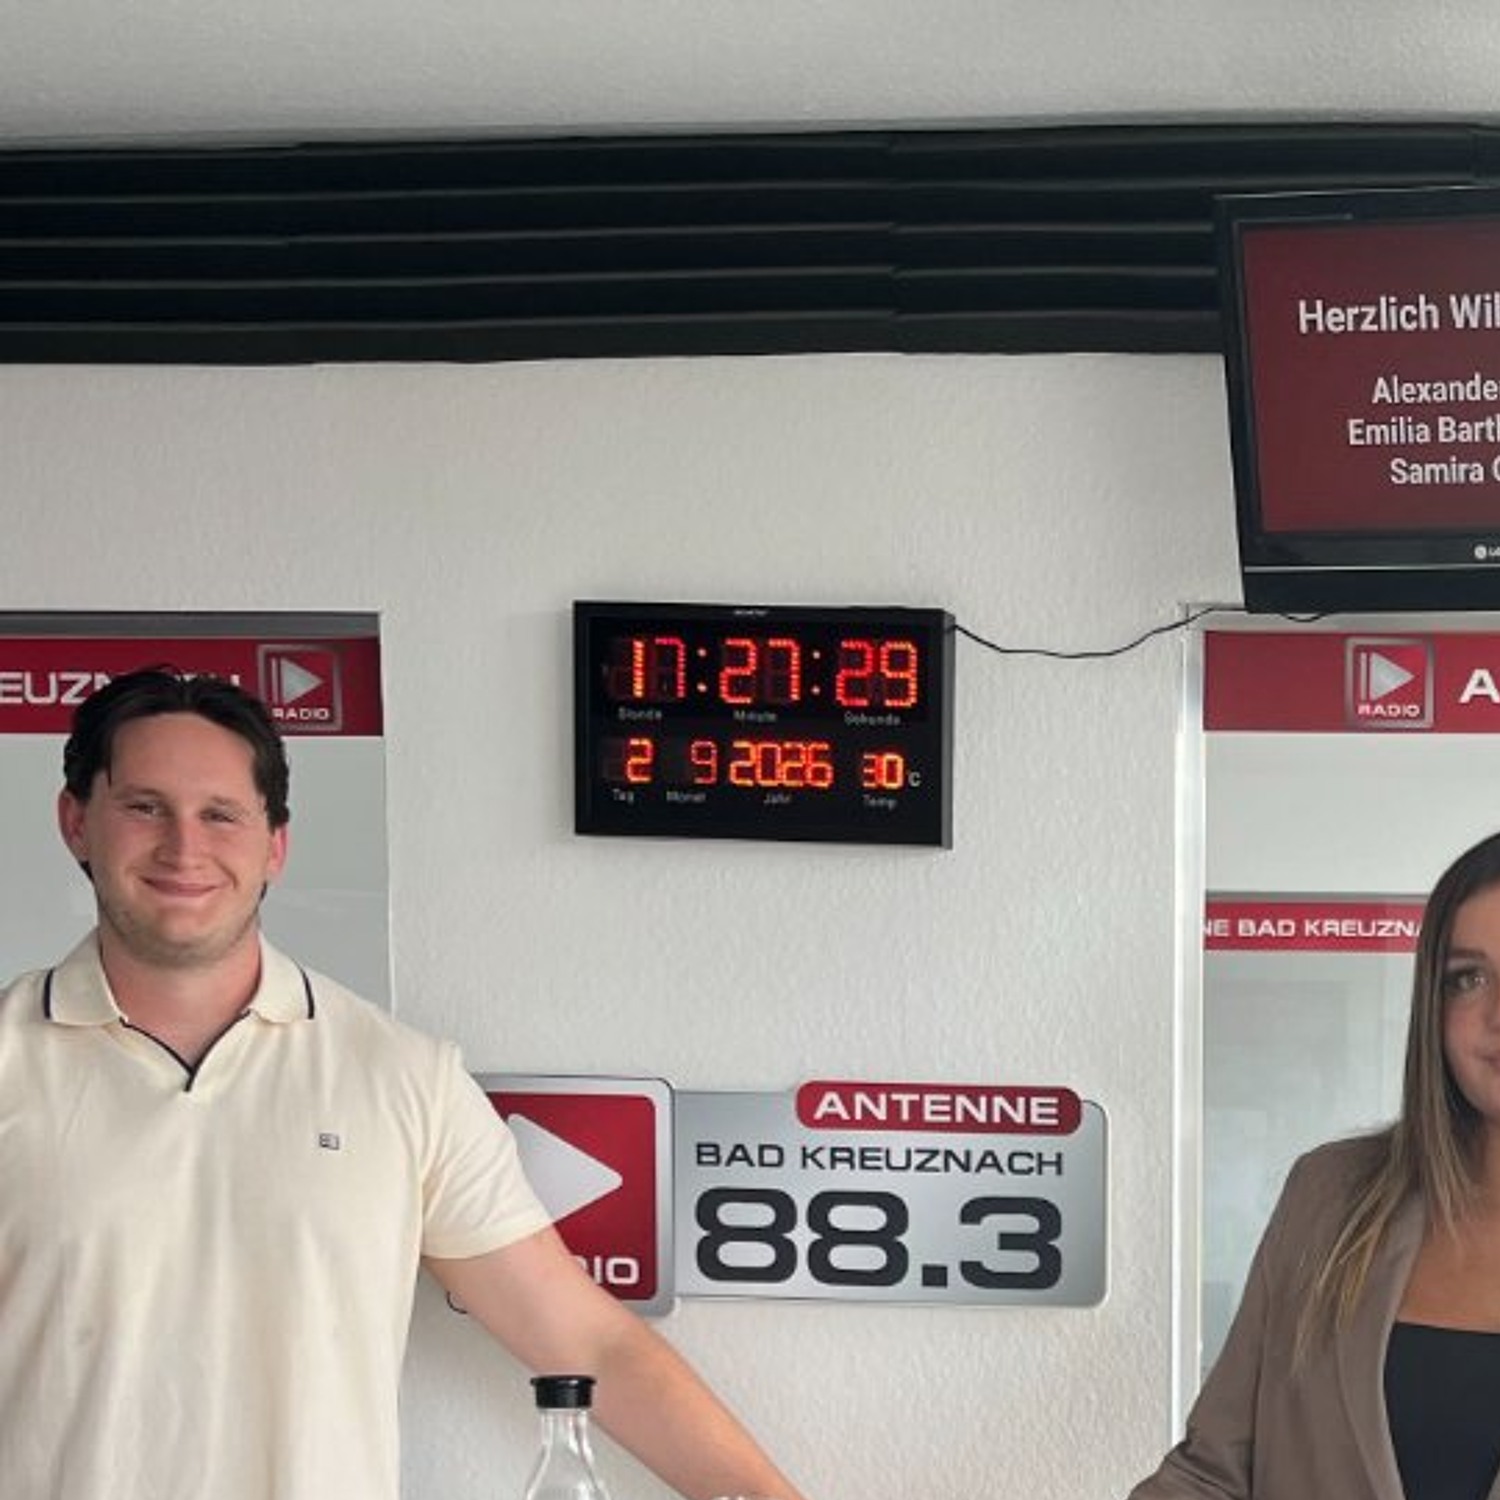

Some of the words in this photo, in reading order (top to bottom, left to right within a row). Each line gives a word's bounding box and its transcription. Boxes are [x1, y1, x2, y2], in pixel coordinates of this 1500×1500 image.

[1298, 294, 1440, 333] Herzlich
[1348, 418, 1431, 445] Emilia
[1390, 458, 1484, 485] Samira
[631, 636, 918, 708] 17:27:29
[272, 707, 329, 721] RADIO
[1357, 704, 1420, 717] RADIO
[626, 738, 654, 783] 2
[690, 740, 717, 784] 9
[729, 741, 834, 788] 2026
[862, 753, 904, 789] 30
[1238, 919, 1296, 937] BAD
[813, 1090, 1060, 1126] ANTENNE
[695, 1143, 785, 1168] BAD
[802, 1146, 1064, 1176] KREUZNACH
[695, 1187, 1063, 1291] 88.3
